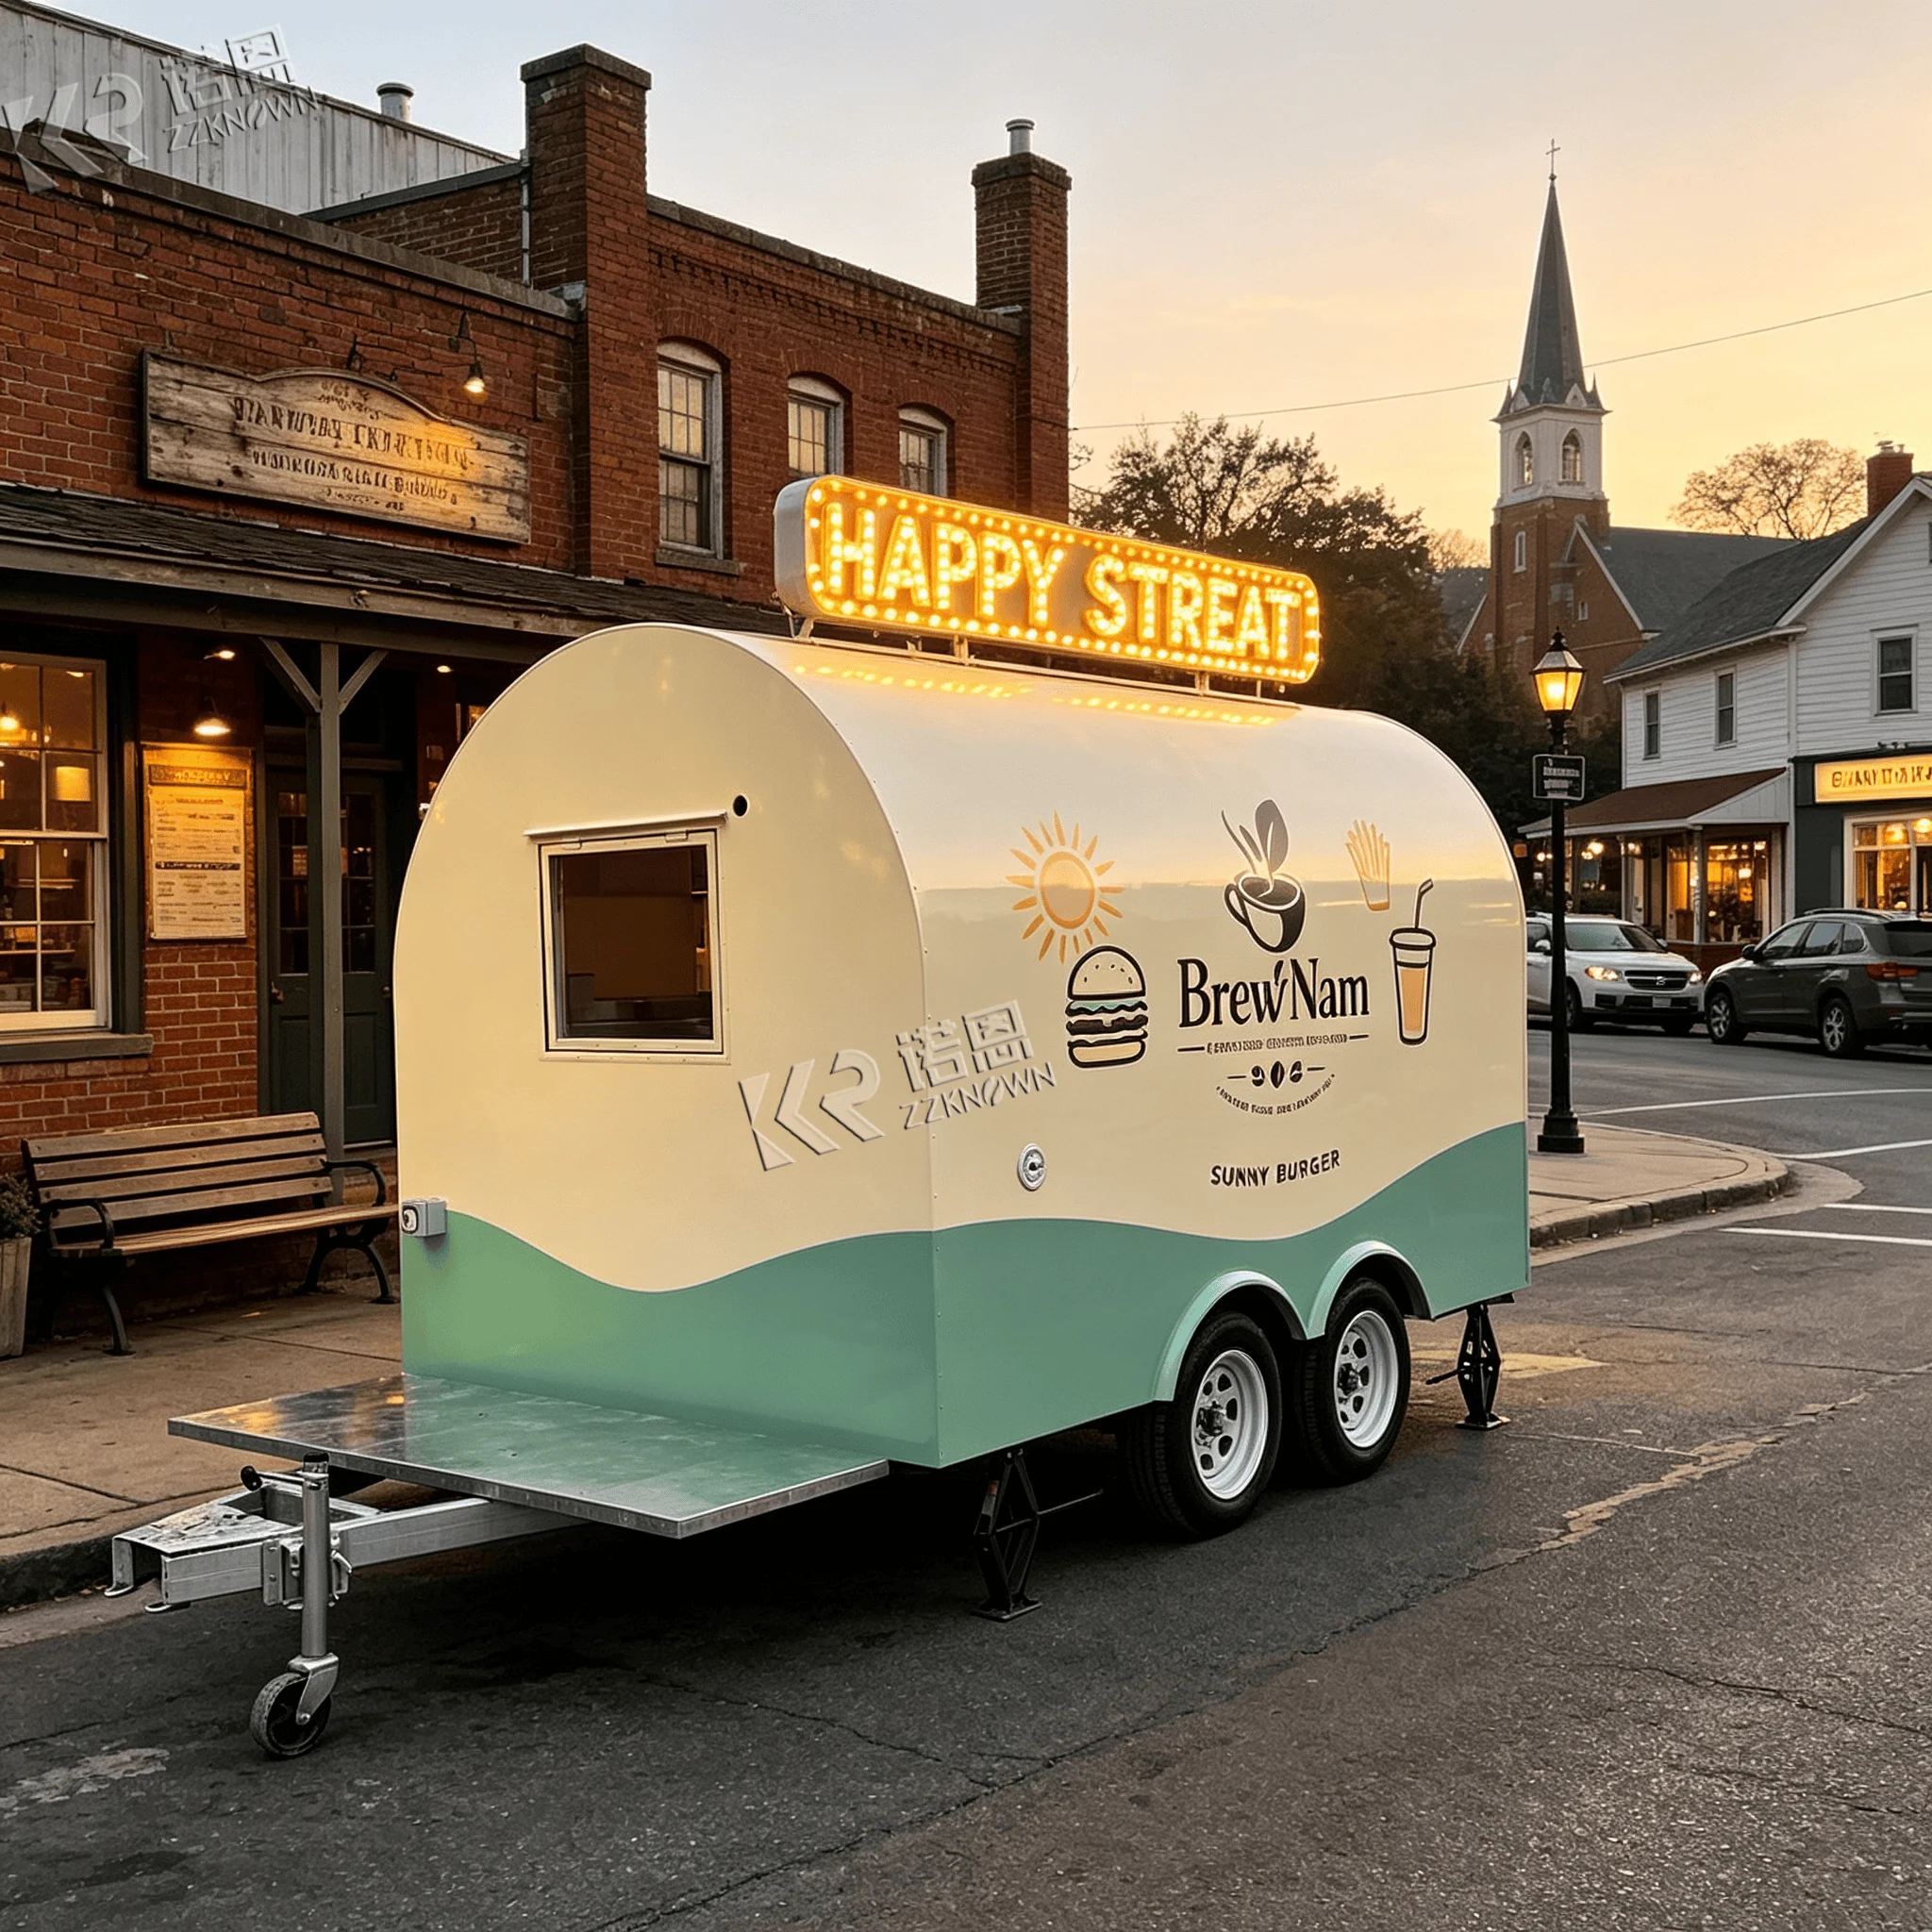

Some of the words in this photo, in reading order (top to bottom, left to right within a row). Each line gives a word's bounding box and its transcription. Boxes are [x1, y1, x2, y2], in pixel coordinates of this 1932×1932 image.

[822, 501, 1069, 627] HAPPY
[1085, 554, 1303, 661] STREAT
[1210, 1165, 1270, 1187] SUNNY
[1276, 1149, 1340, 1183] BURGER
